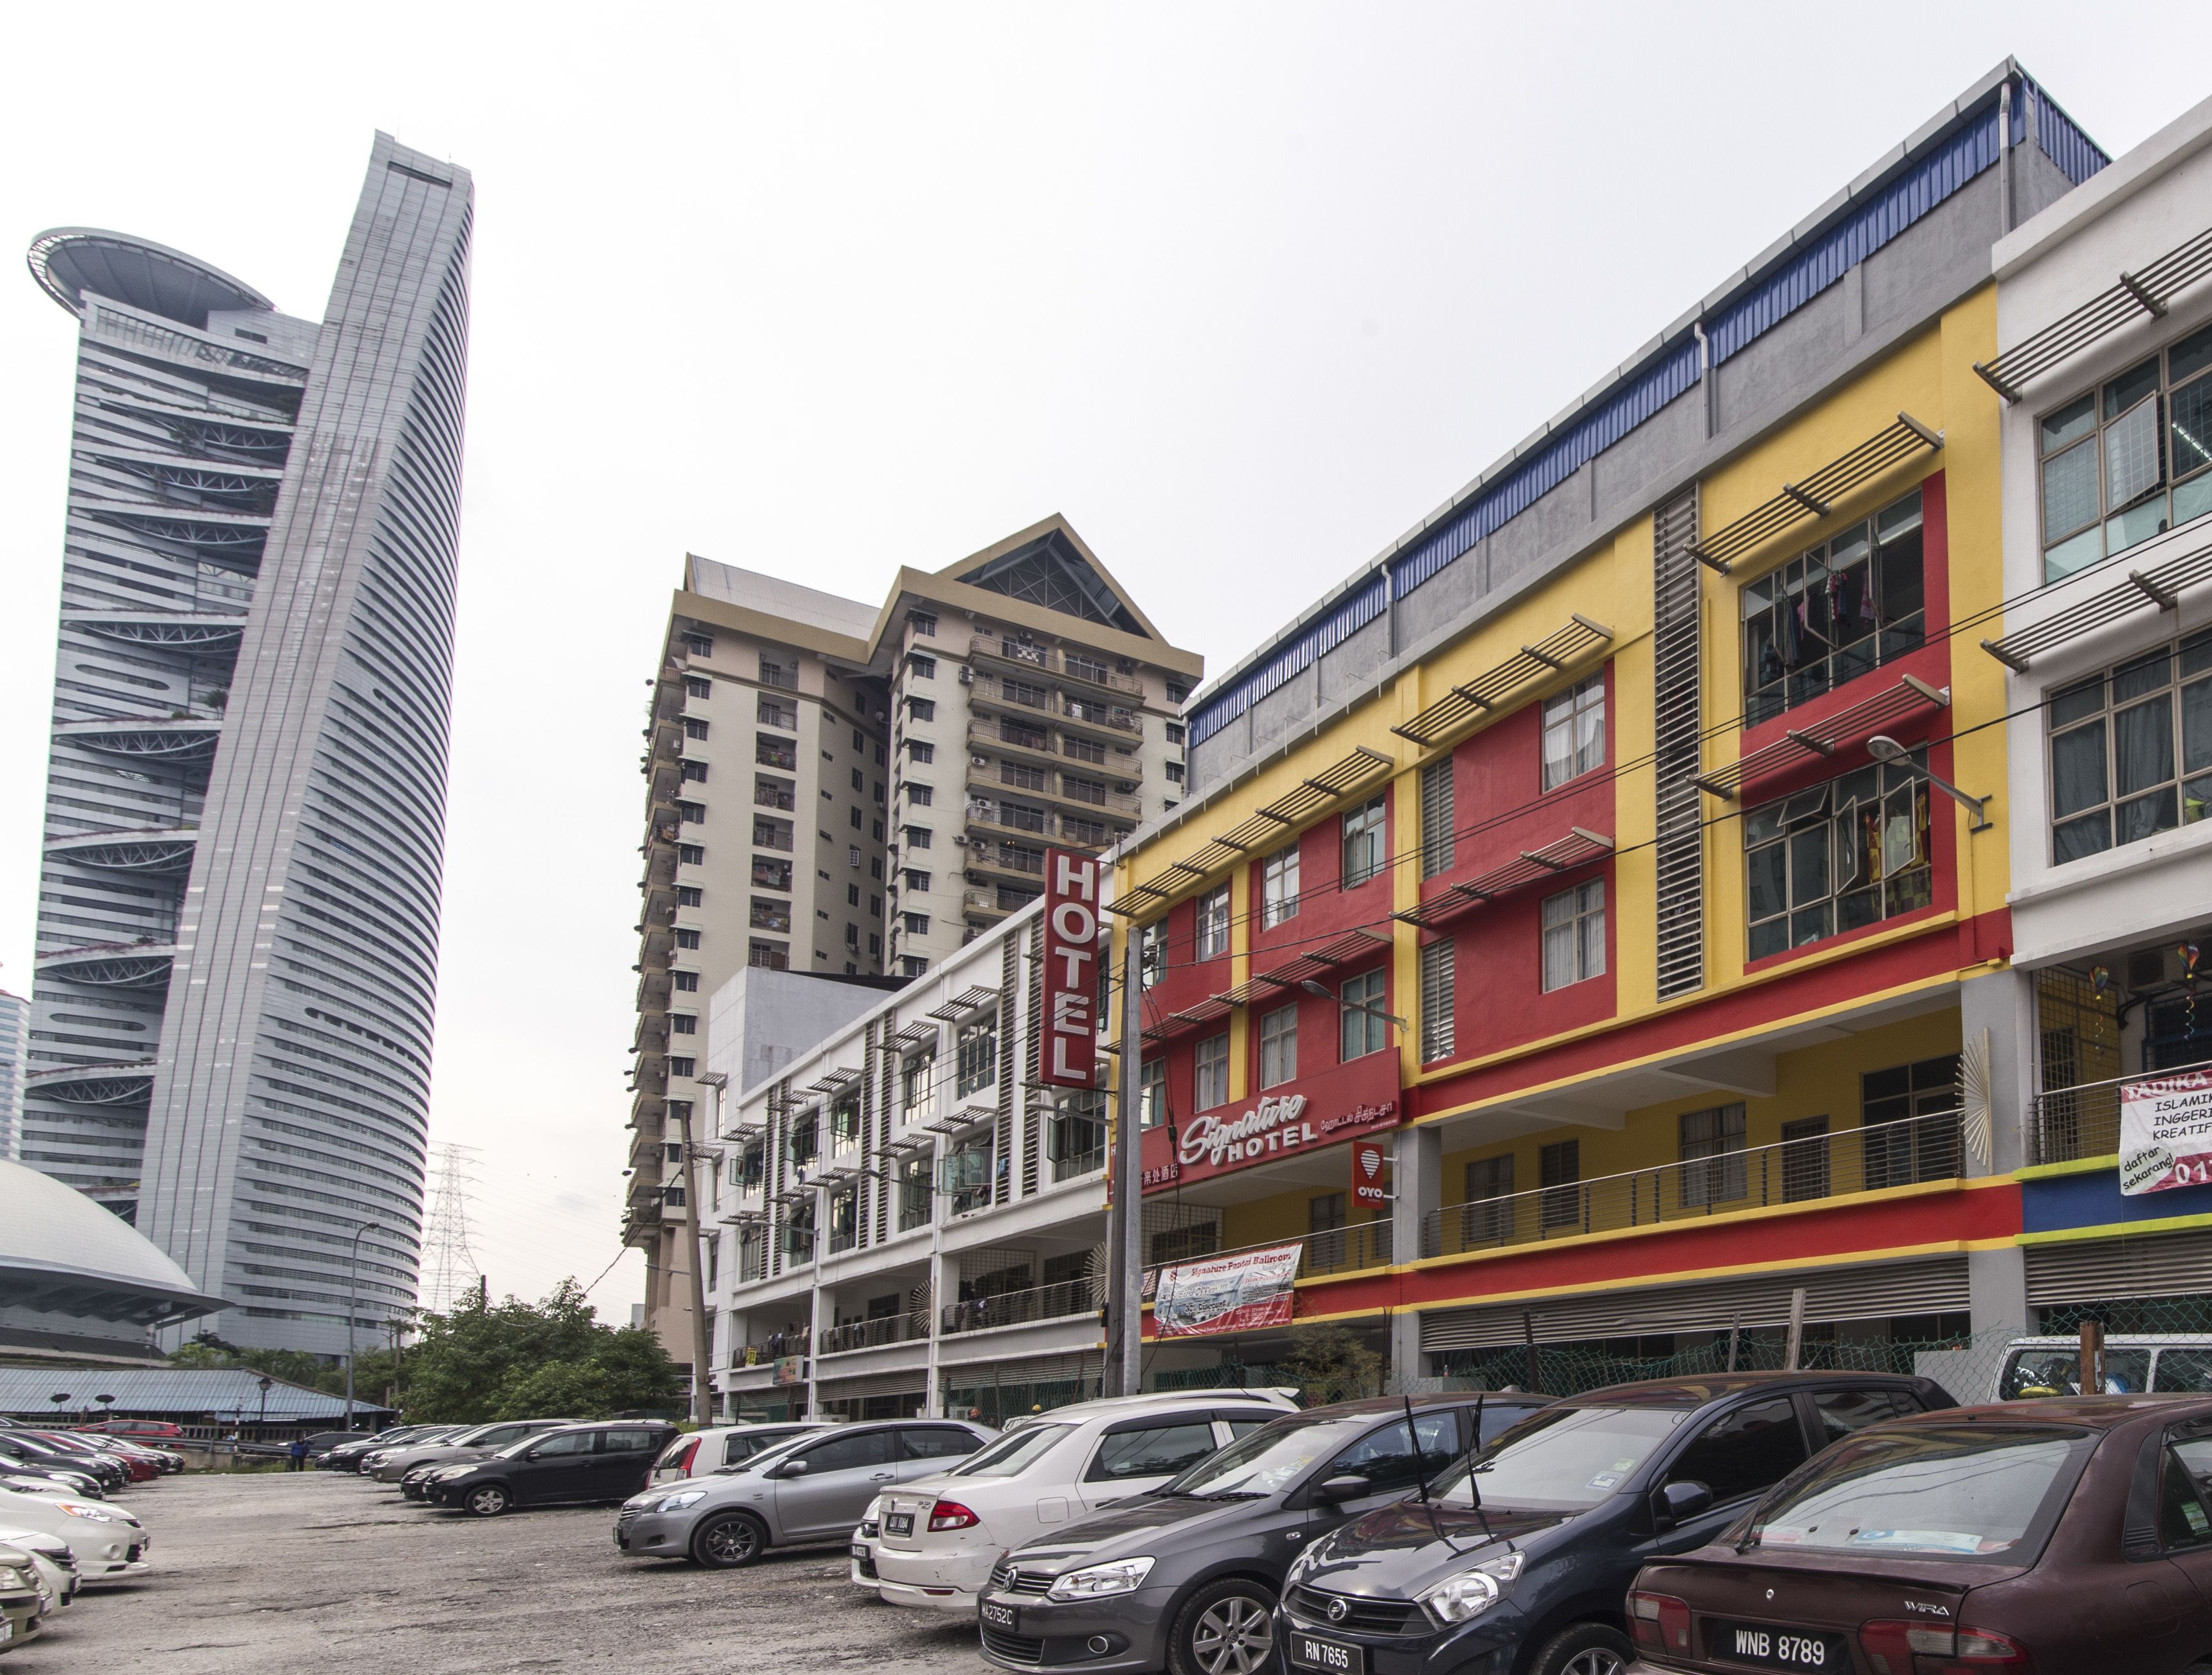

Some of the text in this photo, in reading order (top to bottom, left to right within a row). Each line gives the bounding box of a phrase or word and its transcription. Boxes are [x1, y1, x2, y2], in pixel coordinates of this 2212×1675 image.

[1052, 855, 1095, 1080] HOTEL
[2124, 1072, 2207, 1099] TADIKA
[1179, 1094, 1307, 1166] Signature
[1228, 1122, 1318, 1163] HOTEL
[2153, 1122, 2212, 1141] KREATIF
[2123, 1152, 2174, 1190] sekarang!
[2124, 1147, 2160, 1172] daftar
[1358, 1186, 1383, 1198] OYO
[1191, 1264, 1227, 1277] Signature
[1227, 1257, 1251, 1270] Pantai
[1253, 1253, 1291, 1264] Ballroom
[1198, 1300, 1227, 1311] Discount
[1905, 1601, 1949, 1616] WIRA
[1305, 1640, 1348, 1668] RN 7655
[1736, 1630, 1825, 1665] WNB 8789
